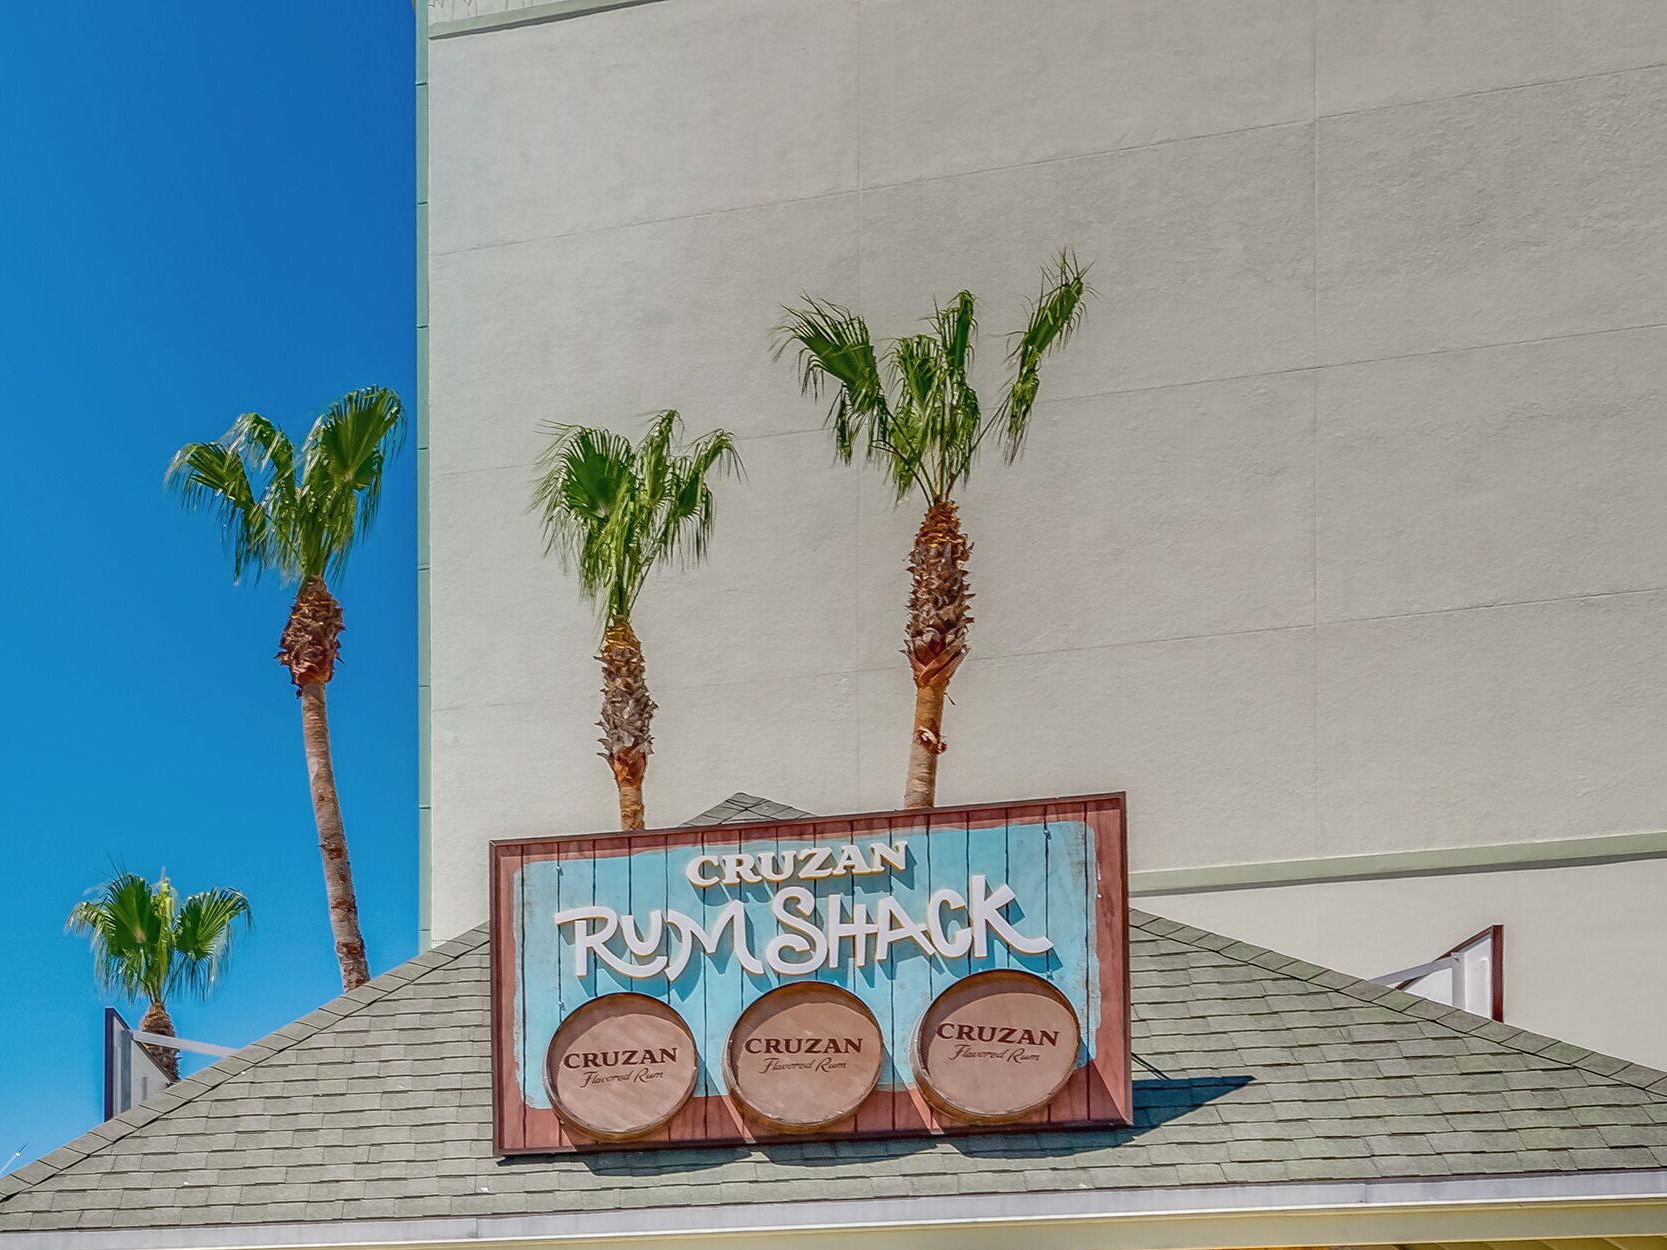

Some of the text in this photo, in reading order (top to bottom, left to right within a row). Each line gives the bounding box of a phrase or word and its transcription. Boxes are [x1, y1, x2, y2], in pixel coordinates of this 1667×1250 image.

[686, 840, 908, 888] CRUZAN
[554, 874, 1054, 982] RUM SHACK
[936, 1023, 1060, 1046] CRUZAN
[744, 1038, 863, 1054] CRUZAN
[948, 1043, 1040, 1064] Flavored Rum
[563, 1047, 678, 1069] CRUZAN
[758, 1057, 846, 1074] Flavored Rum
[579, 1067, 663, 1089] Flavored Rum
